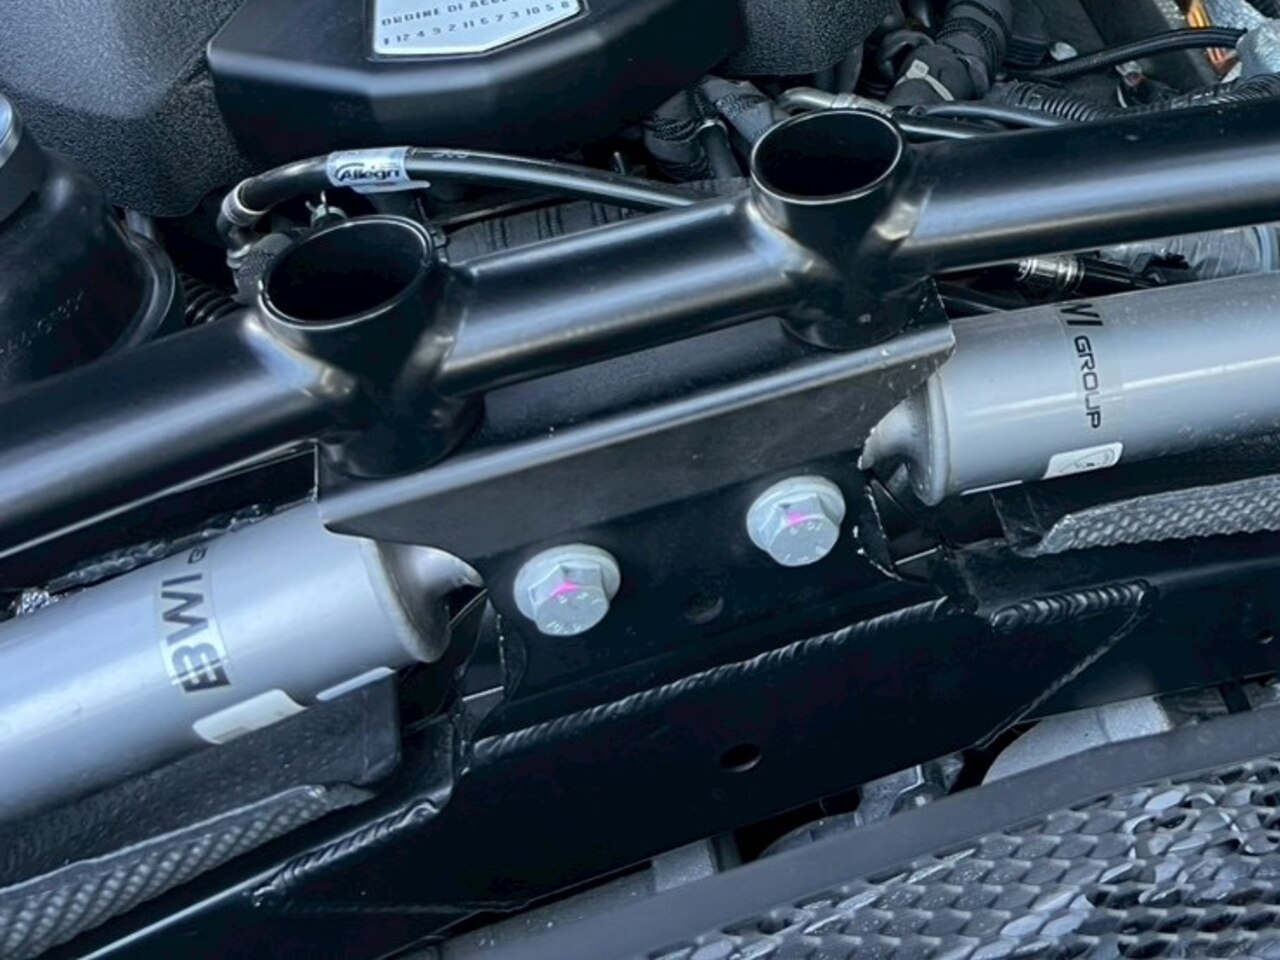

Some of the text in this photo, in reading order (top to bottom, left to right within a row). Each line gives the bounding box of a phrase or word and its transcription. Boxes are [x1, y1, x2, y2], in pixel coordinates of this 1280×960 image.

[381, 8, 440, 26] ORDINE
[447, 3, 464, 14] DI
[1074, 335, 1101, 428] GROUP
[161, 572, 231, 693] BWI
